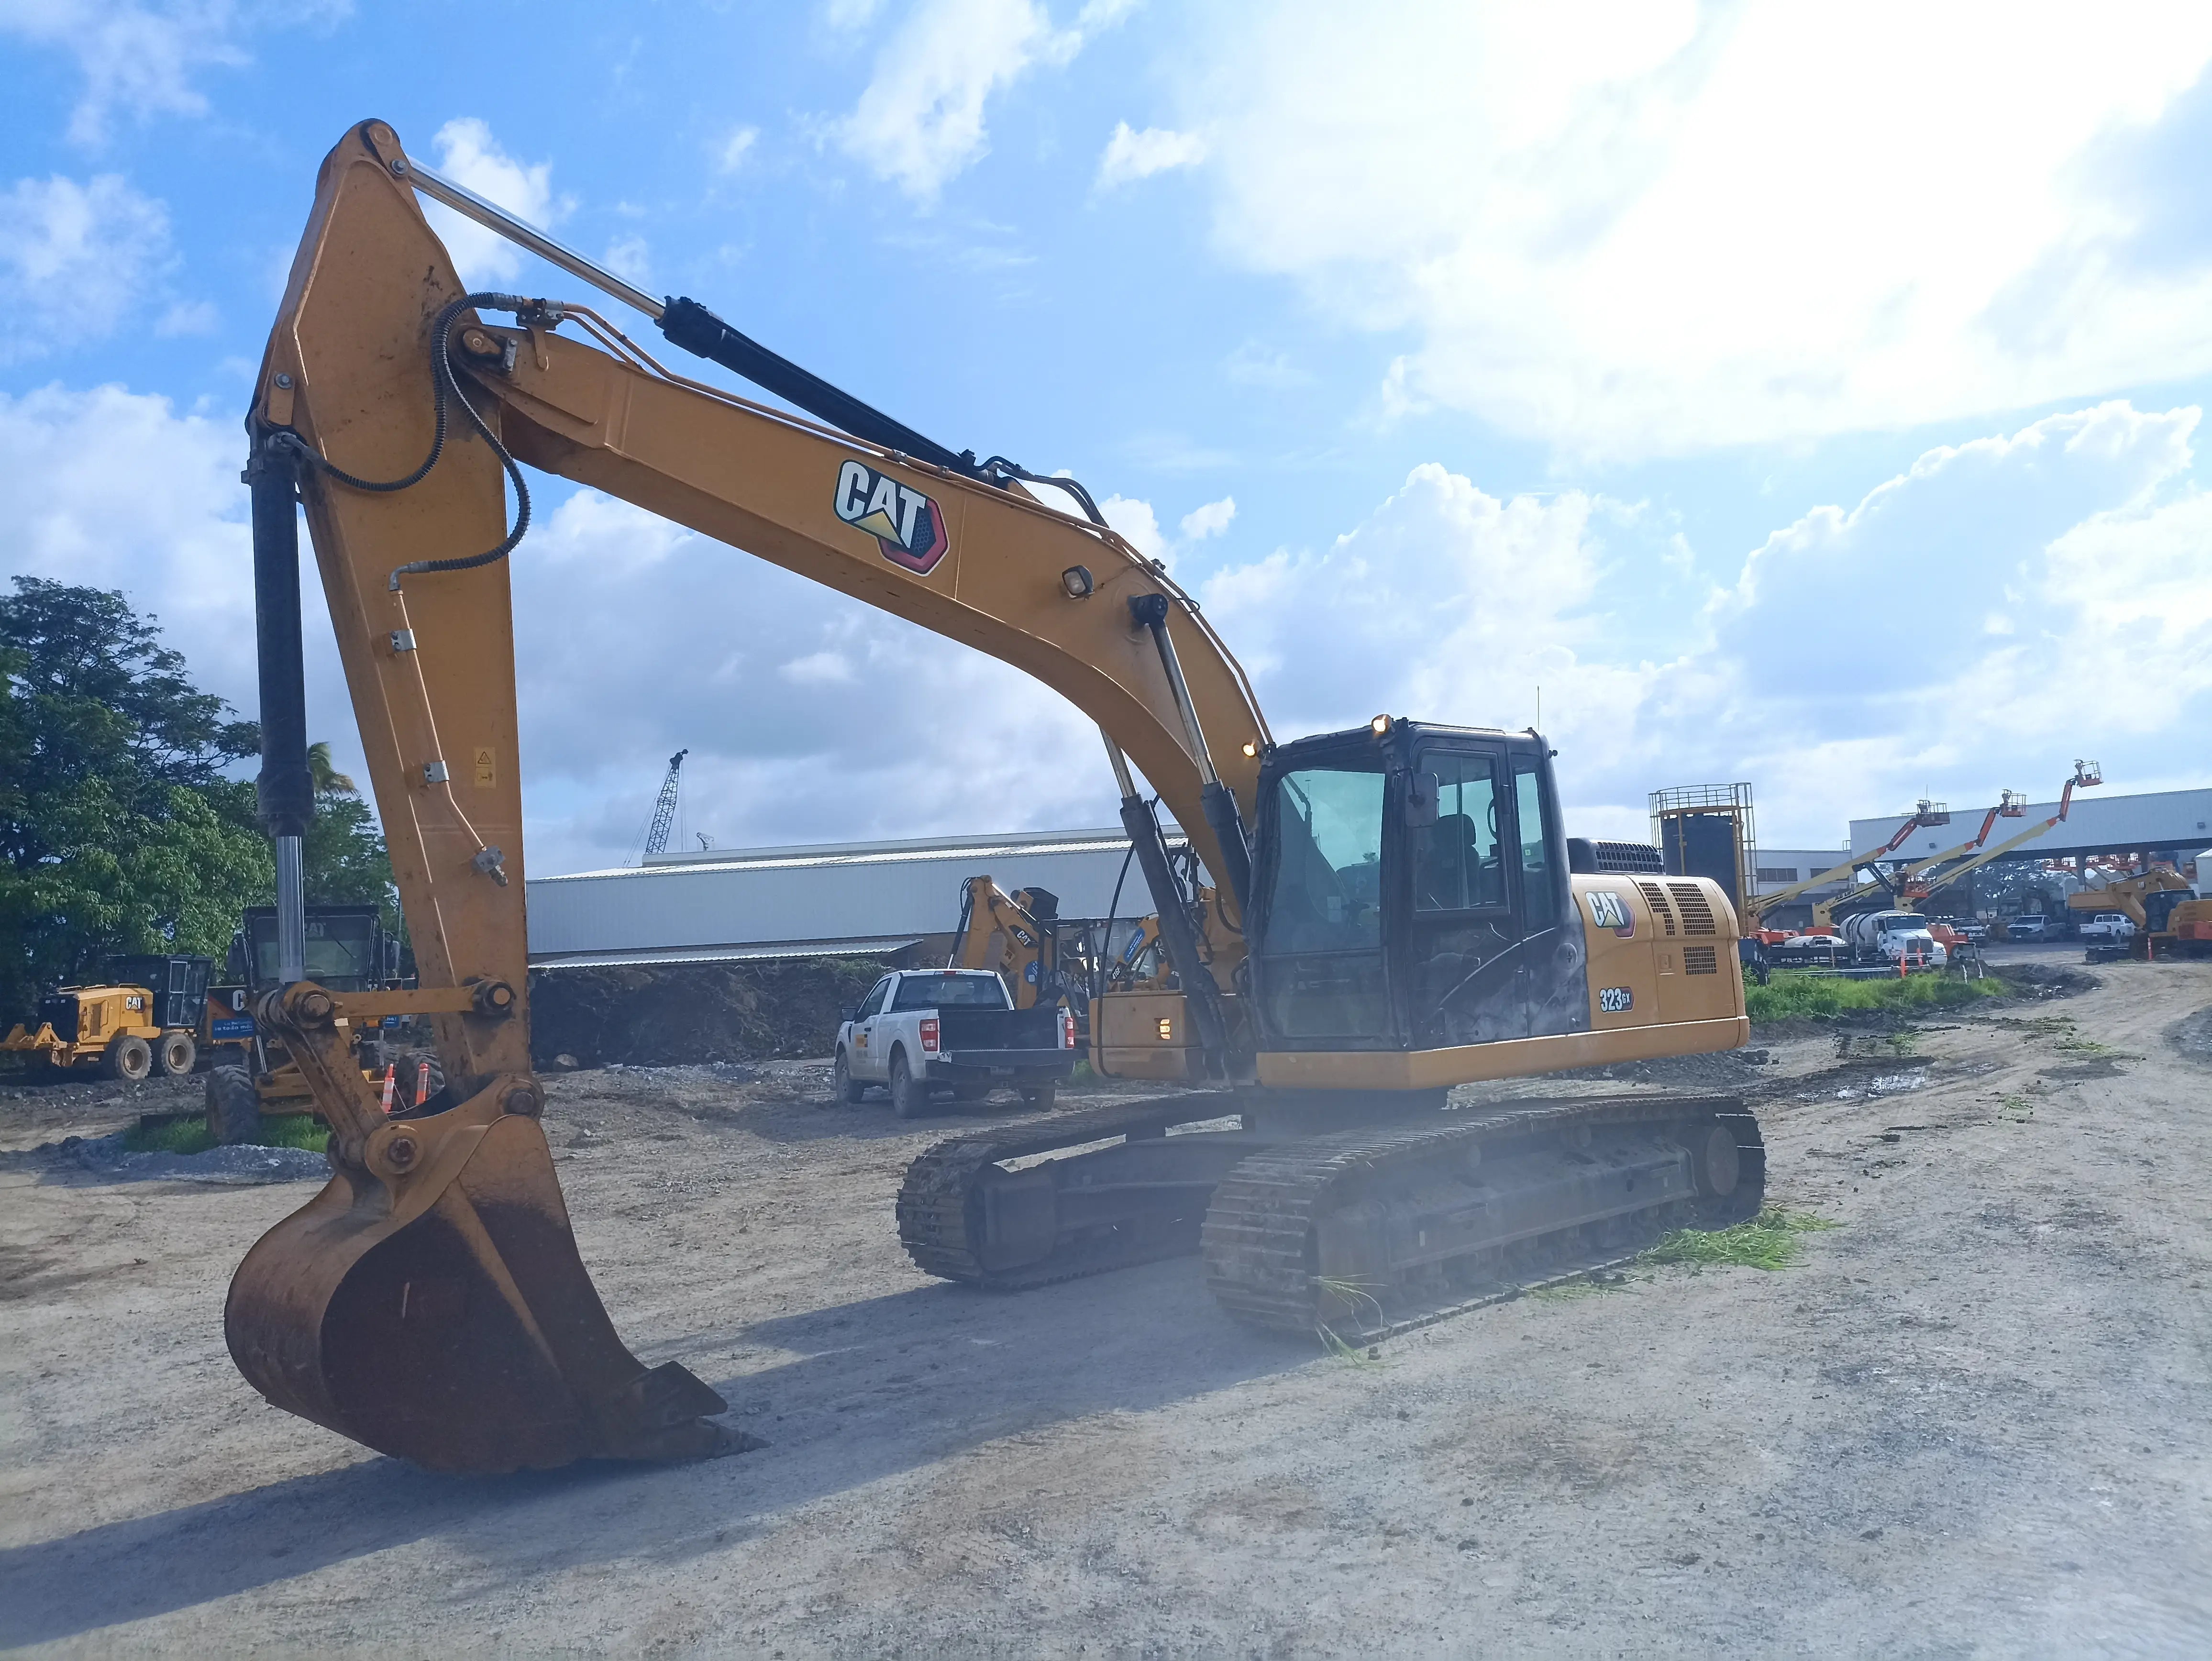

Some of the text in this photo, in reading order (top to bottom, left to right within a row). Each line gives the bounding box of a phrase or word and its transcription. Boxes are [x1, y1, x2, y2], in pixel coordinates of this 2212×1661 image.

[836, 461, 926, 549] CAT
[1585, 892, 1625, 927] CAT
[1017, 930, 1031, 946] CAT
[126, 997, 143, 1009] CAT
